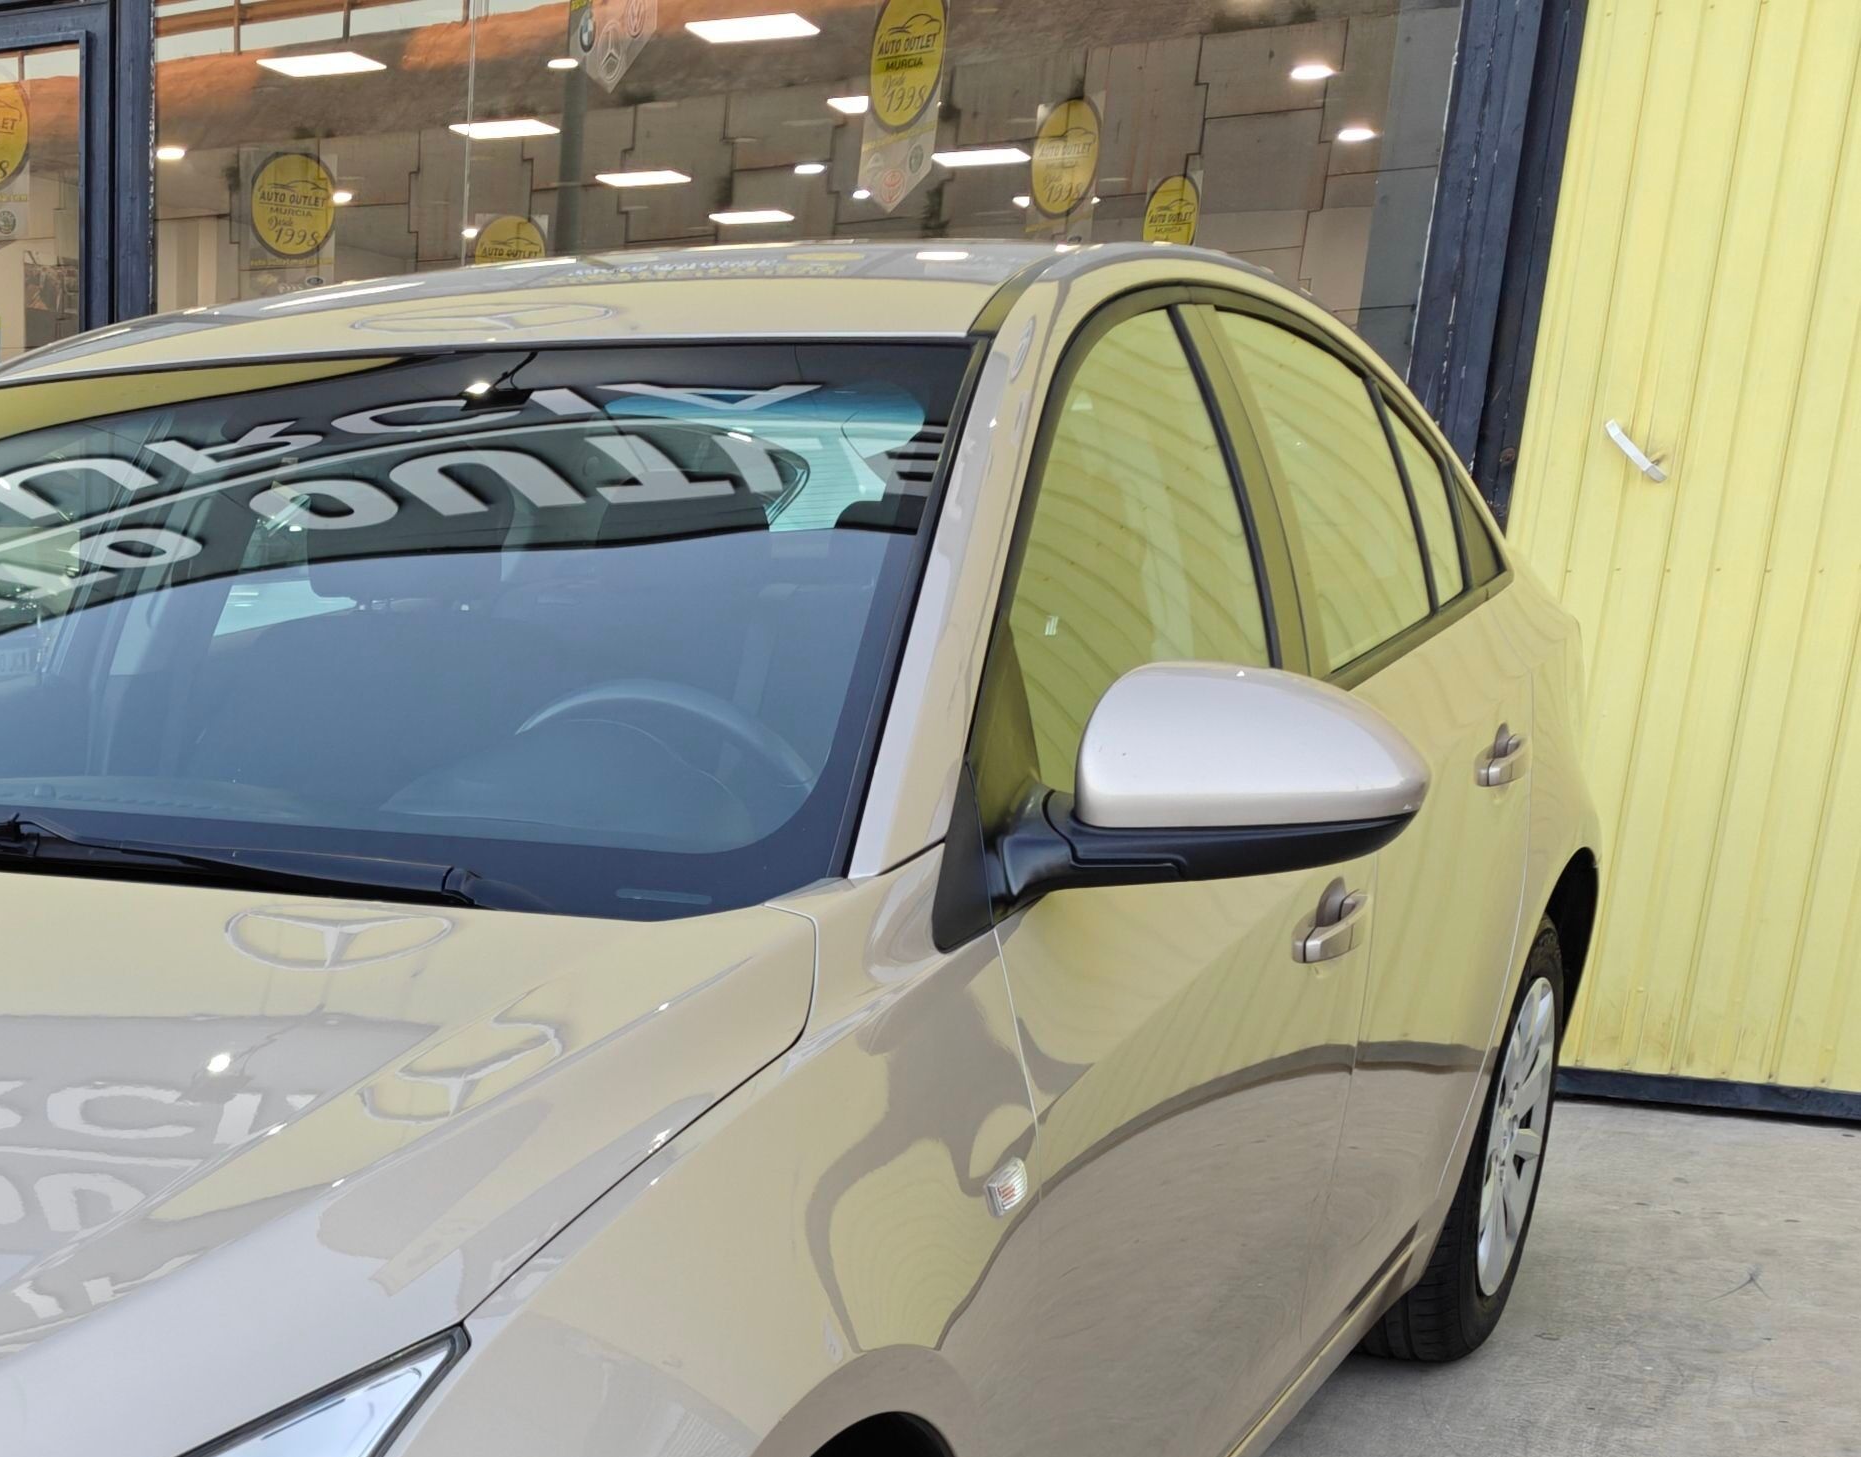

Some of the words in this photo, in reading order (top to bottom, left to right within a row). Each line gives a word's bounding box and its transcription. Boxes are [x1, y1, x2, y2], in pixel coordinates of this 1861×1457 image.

[878, 39, 901, 56] AUTO
[905, 33, 938, 51] OUTLET
[885, 56, 923, 71] MURCIA
[886, 84, 927, 112] 1998
[260, 191, 285, 202] AUTO
[289, 195, 325, 207] OUTLET
[270, 207, 312, 217] MURCIA
[274, 227, 319, 247] 1998
[482, 247, 504, 257] AUTO
[507, 249, 538, 258] OUTLET
